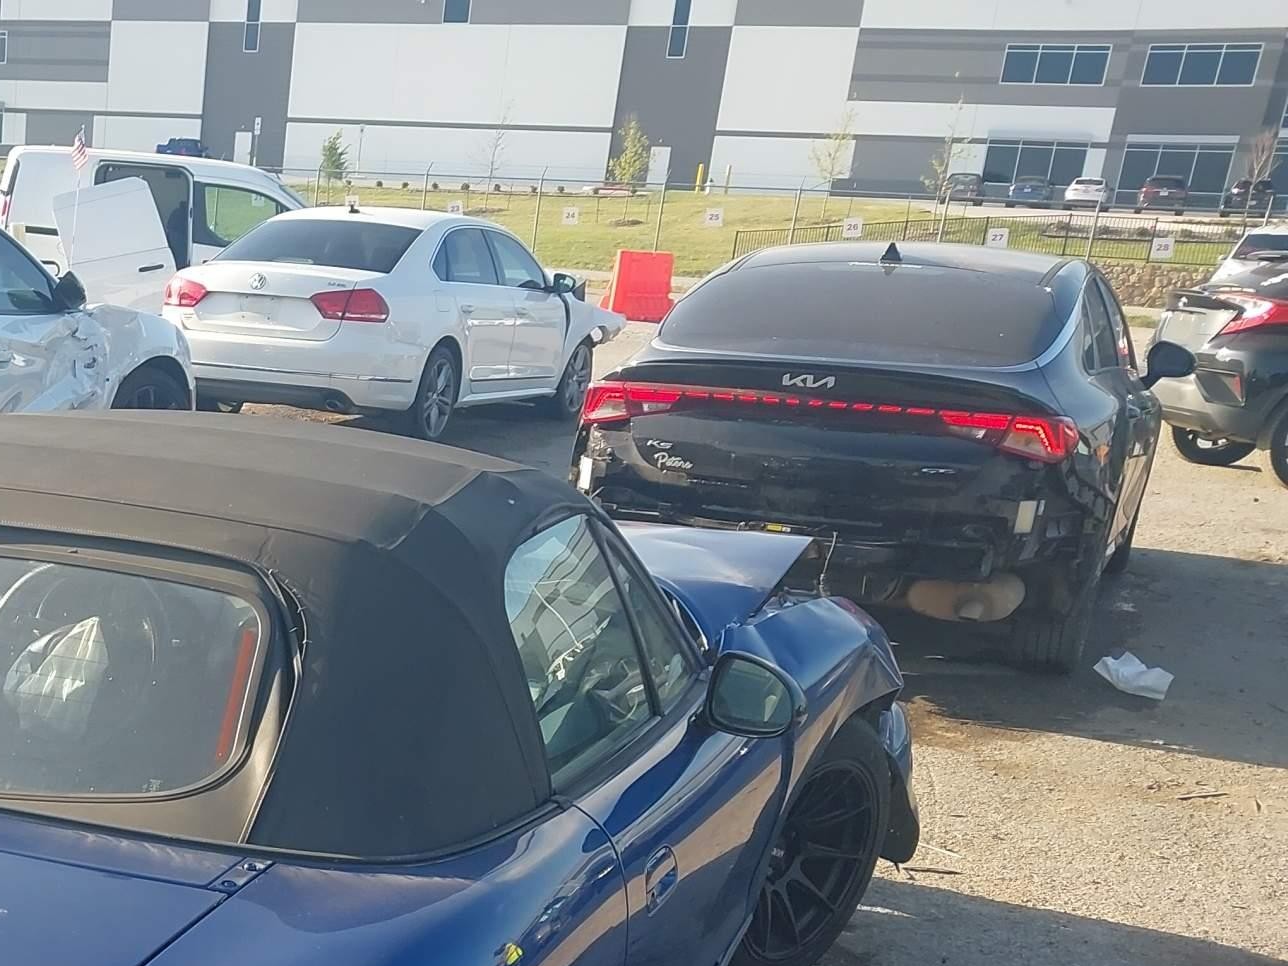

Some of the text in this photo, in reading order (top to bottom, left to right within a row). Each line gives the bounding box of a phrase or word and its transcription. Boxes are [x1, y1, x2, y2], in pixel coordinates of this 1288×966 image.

[708, 213, 720, 221] 25
[846, 223, 859, 231] 26
[991, 233, 1004, 242] 27
[1156, 243, 1169, 251] 28
[782, 373, 837, 389] KIA
[646, 440, 673, 449] K5
